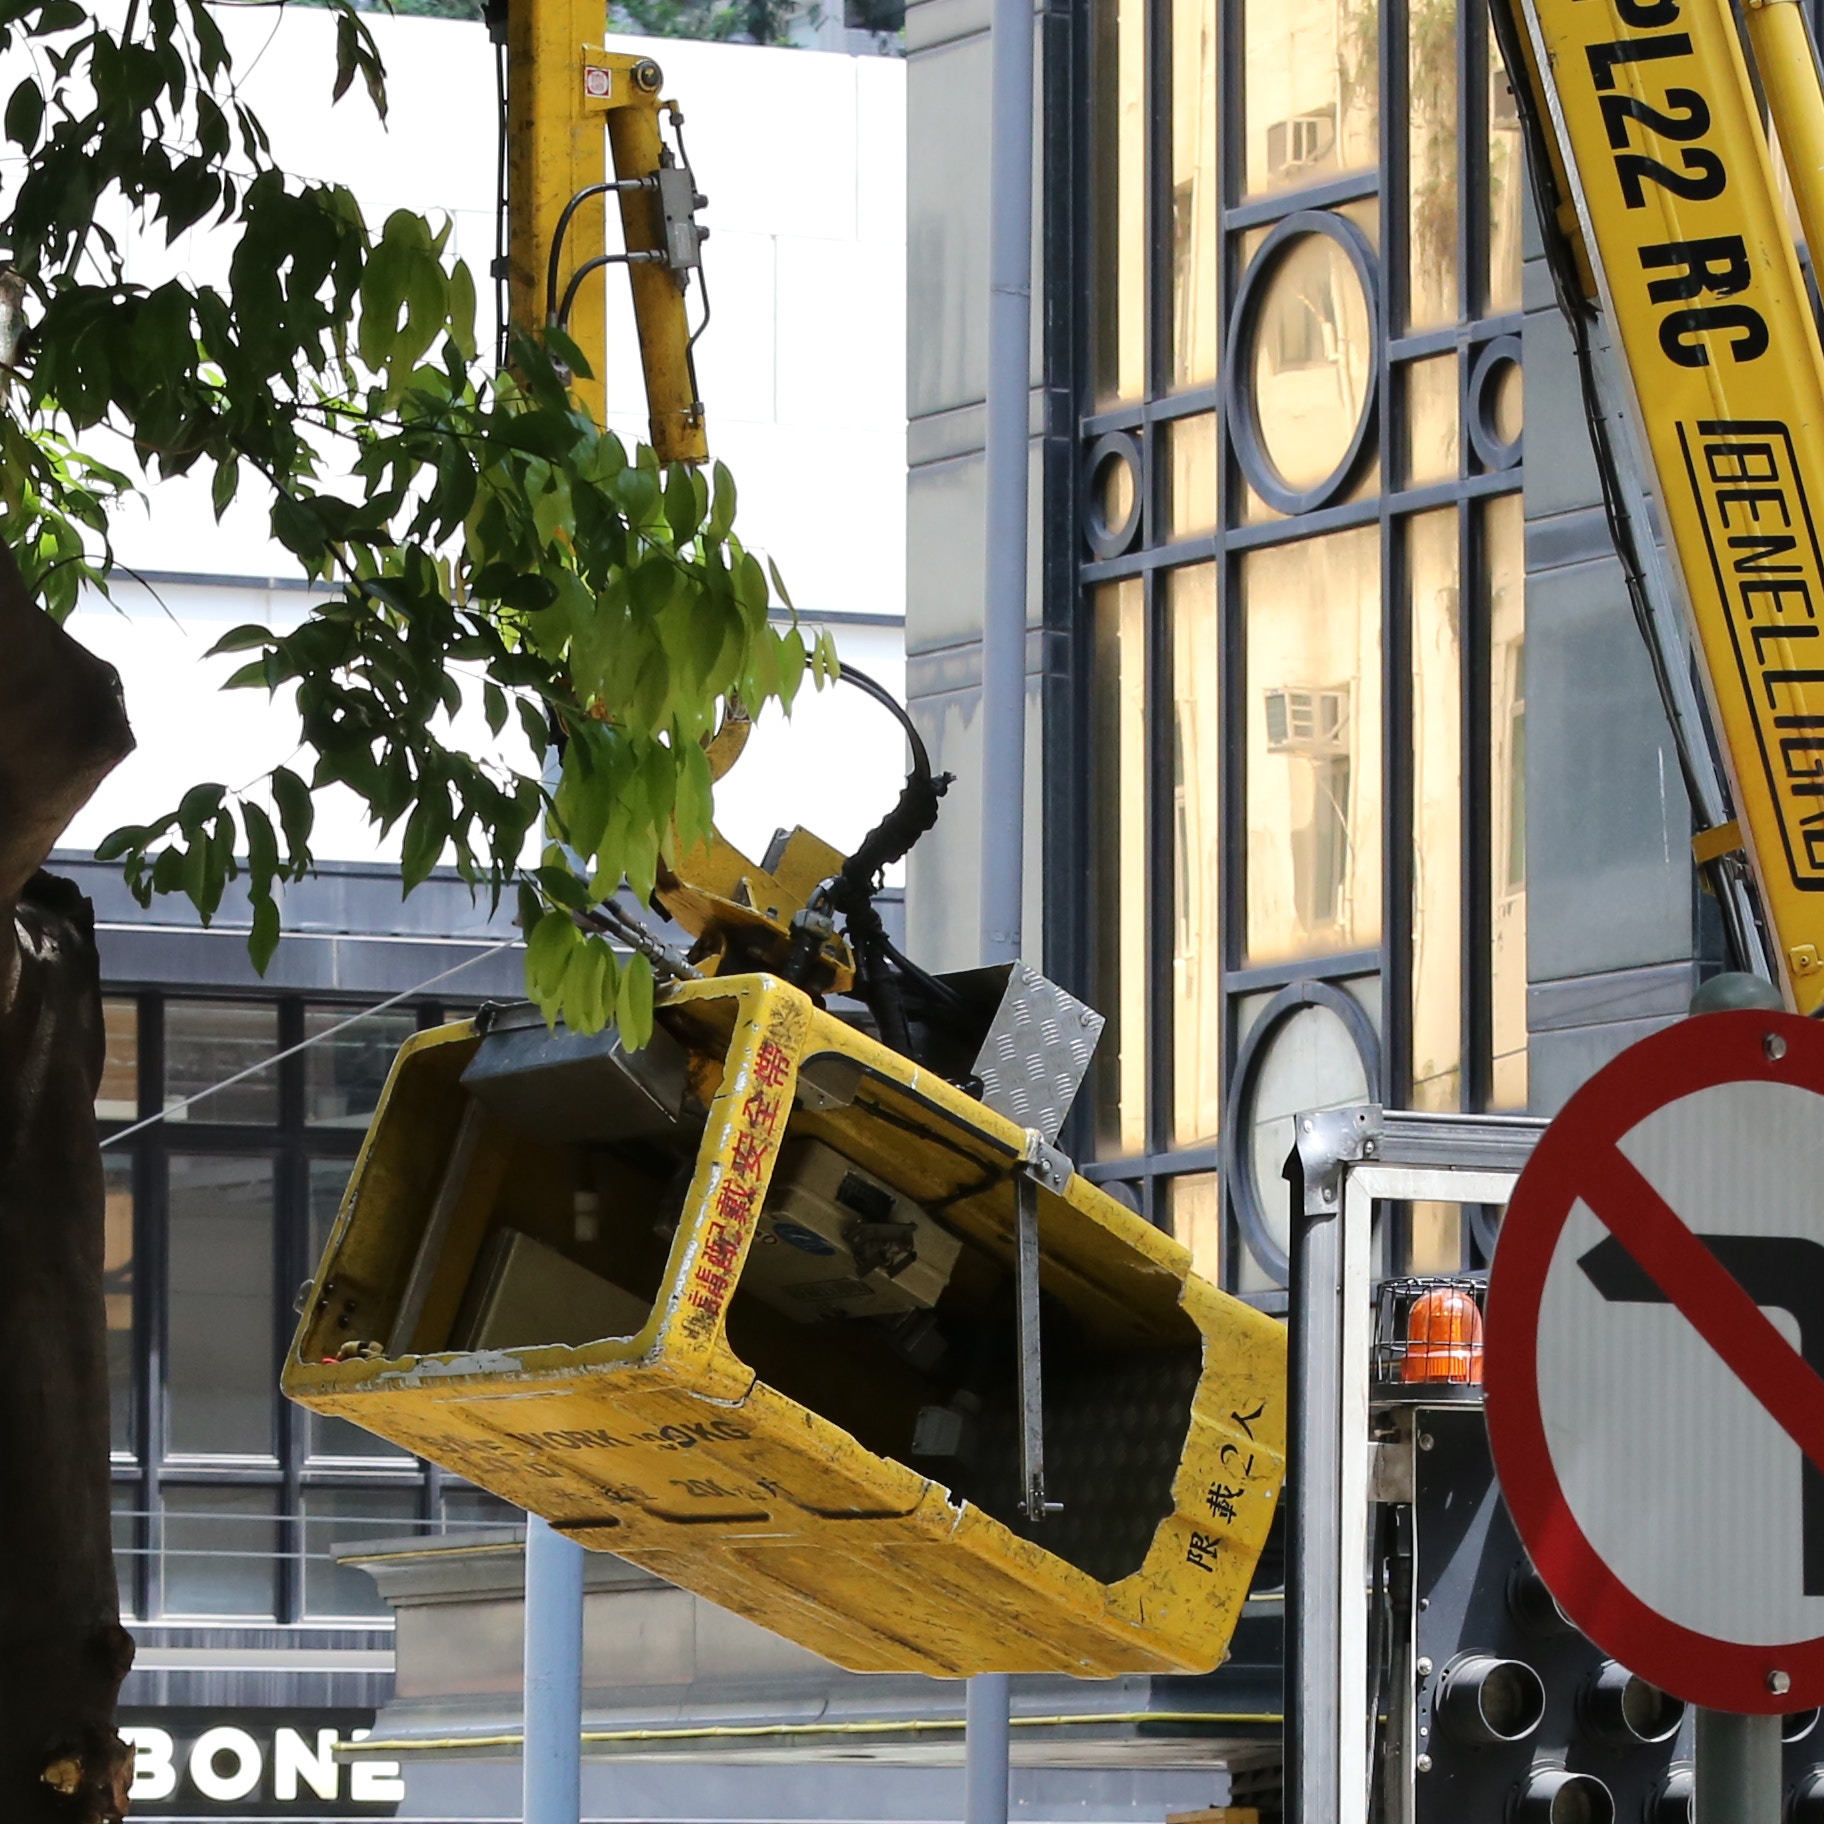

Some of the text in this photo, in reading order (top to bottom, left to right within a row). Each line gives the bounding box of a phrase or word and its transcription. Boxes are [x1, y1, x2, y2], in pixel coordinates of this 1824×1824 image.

[1637, 234, 1769, 372] RC
[1185, 1397, 1268, 1573] 限載2人
